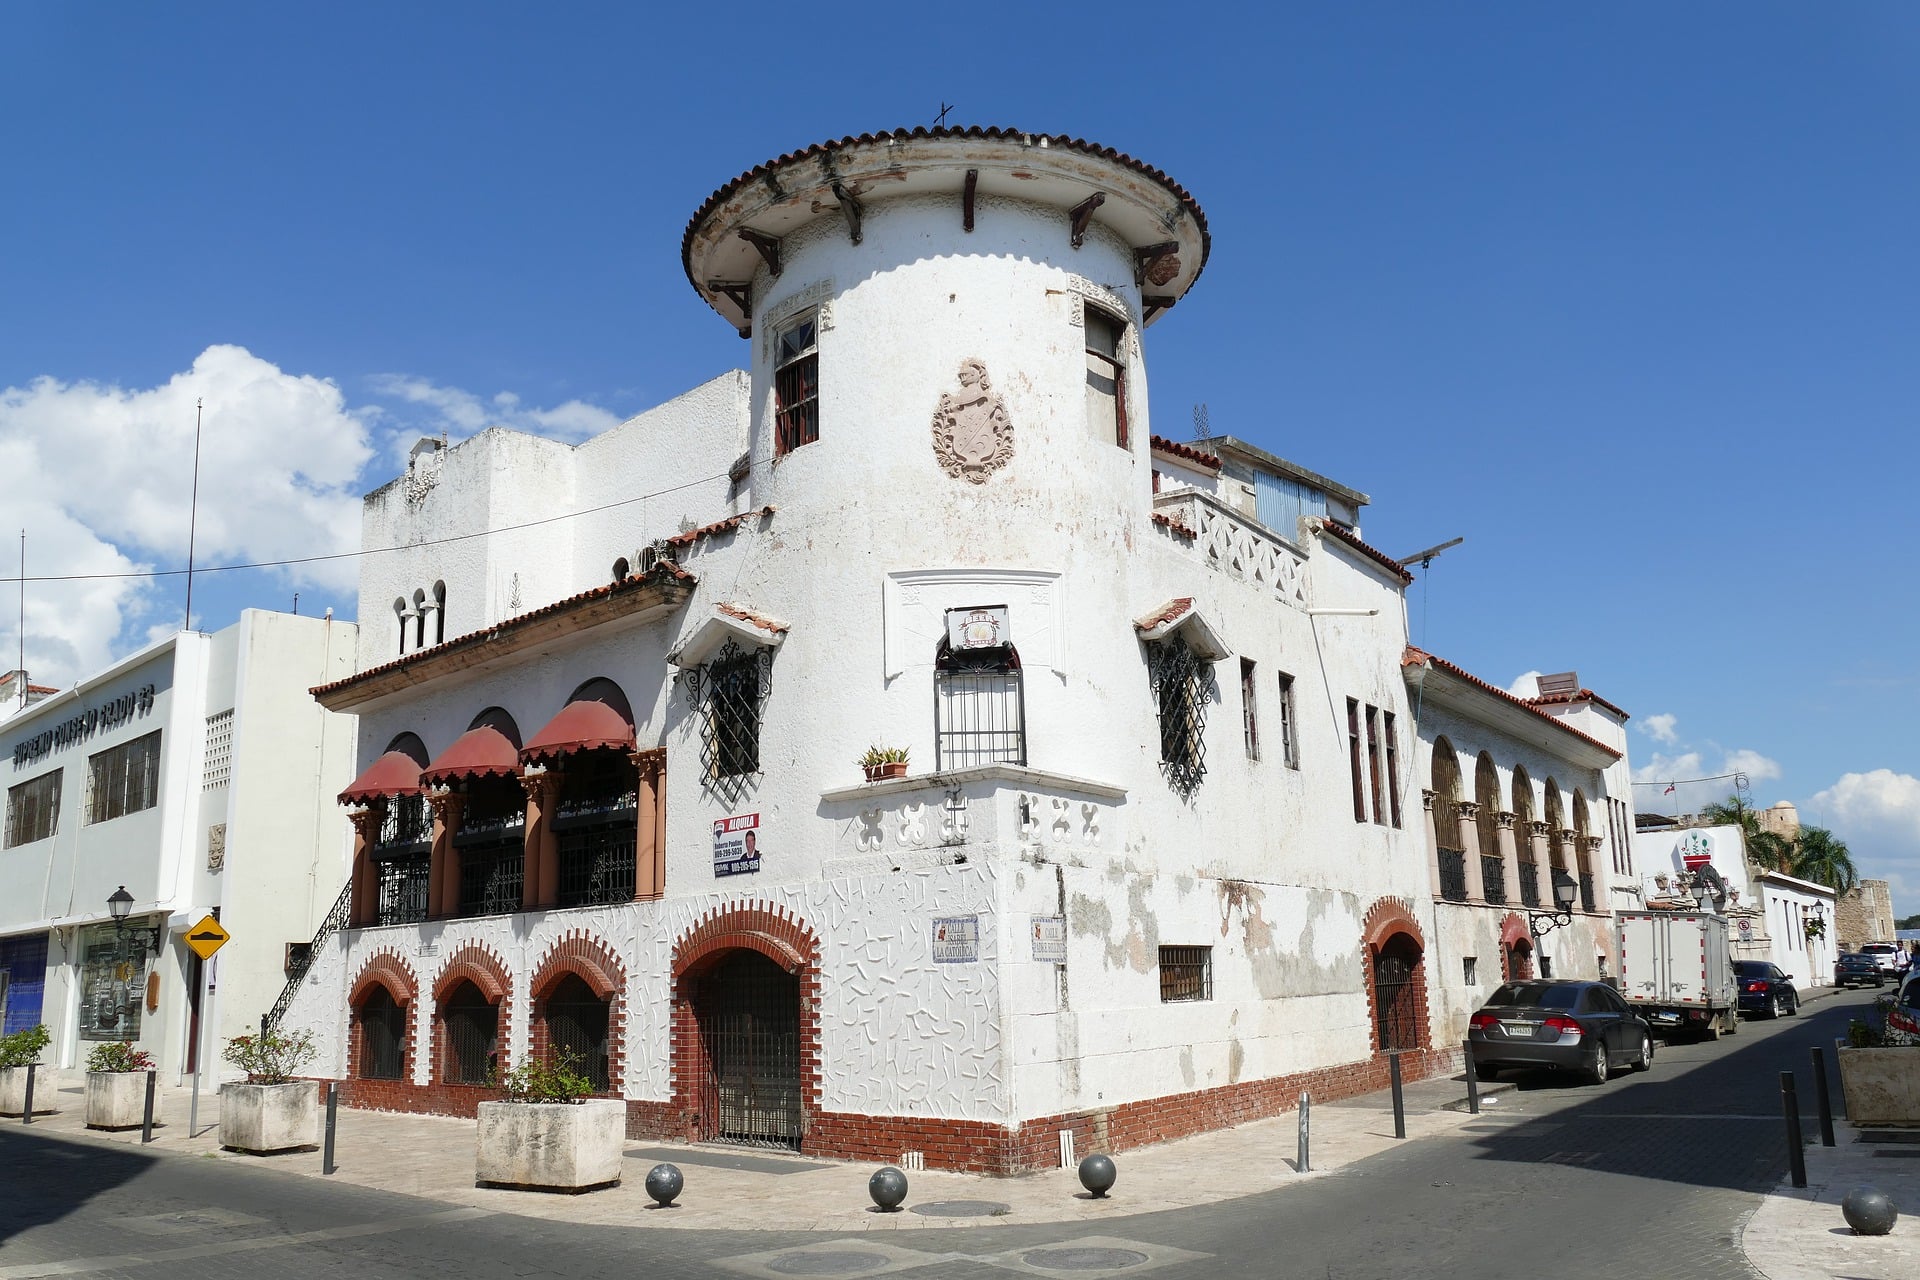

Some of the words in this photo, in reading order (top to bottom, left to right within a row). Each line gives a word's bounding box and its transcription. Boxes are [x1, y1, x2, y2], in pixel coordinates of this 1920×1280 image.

[14, 730, 53, 765] SUPREMO
[54, 709, 98, 747] CONSEJO
[100, 692, 136, 727] GRADO
[729, 816, 754, 831] ALQUILA
[947, 923, 964, 934] CALLE
[947, 934, 967, 945] ISABEL
[936, 946, 944, 957] LA
